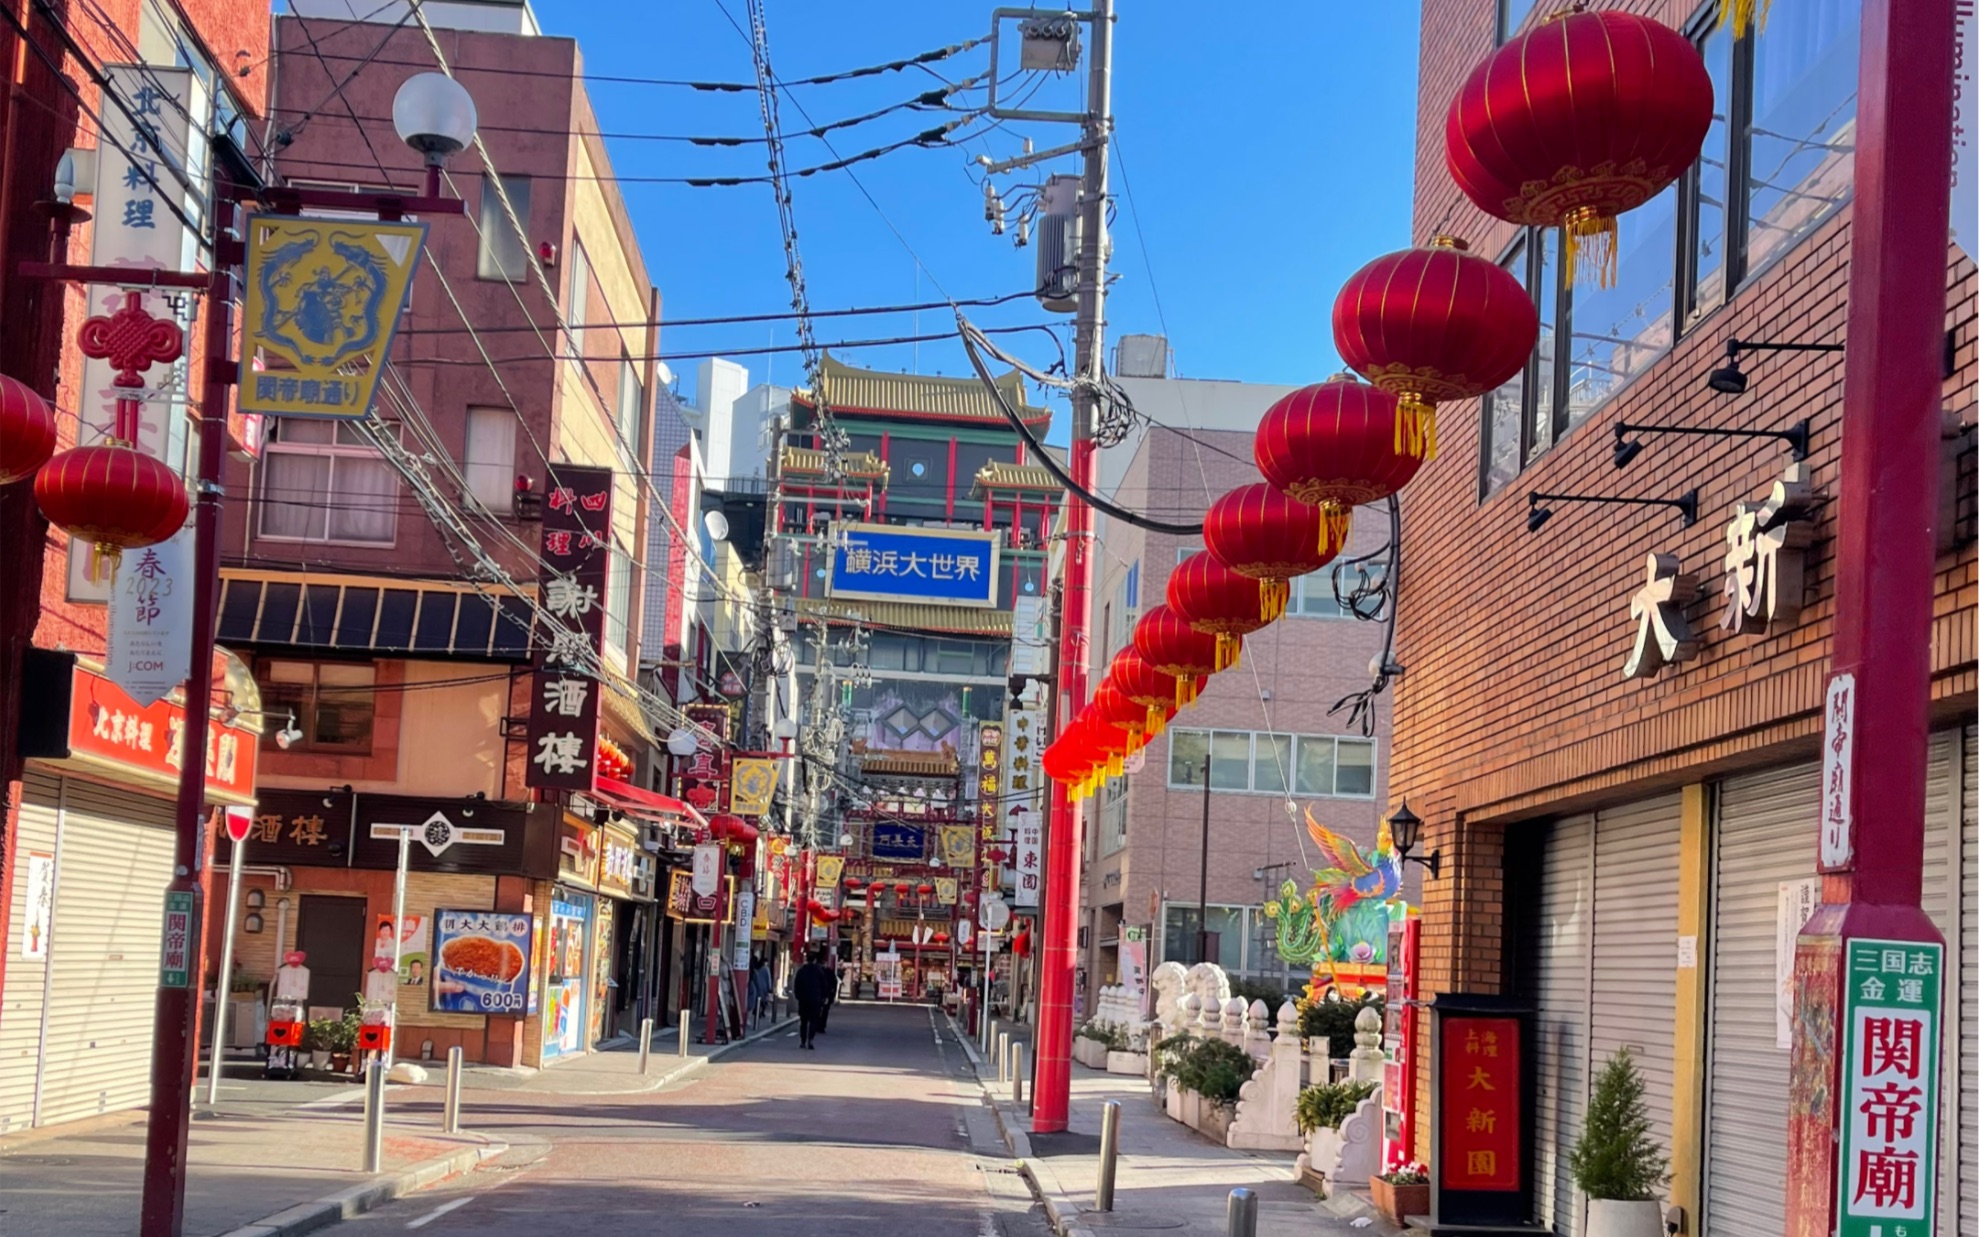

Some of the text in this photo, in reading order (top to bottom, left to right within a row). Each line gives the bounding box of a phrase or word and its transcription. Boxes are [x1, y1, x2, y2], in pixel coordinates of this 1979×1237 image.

[121, 86, 161, 229] 北京料理
[546, 487, 577, 556] 料理
[578, 490, 607, 549] 四川
[125, 576, 173, 597] 2023
[845, 548, 981, 582] 横浜大世界
[93, 705, 154, 752] 北京料理
[1828, 687, 1850, 849] 関帝廟通り
[739, 900, 749, 927] CBD
[1800, 883, 1810, 926] 謹賀
[1854, 949, 1934, 976] 三国志
[1860, 976, 1924, 1003] 金運
[1466, 1066, 1497, 1177] 大新園
[1852, 1015, 1924, 1209] 関帝廟
